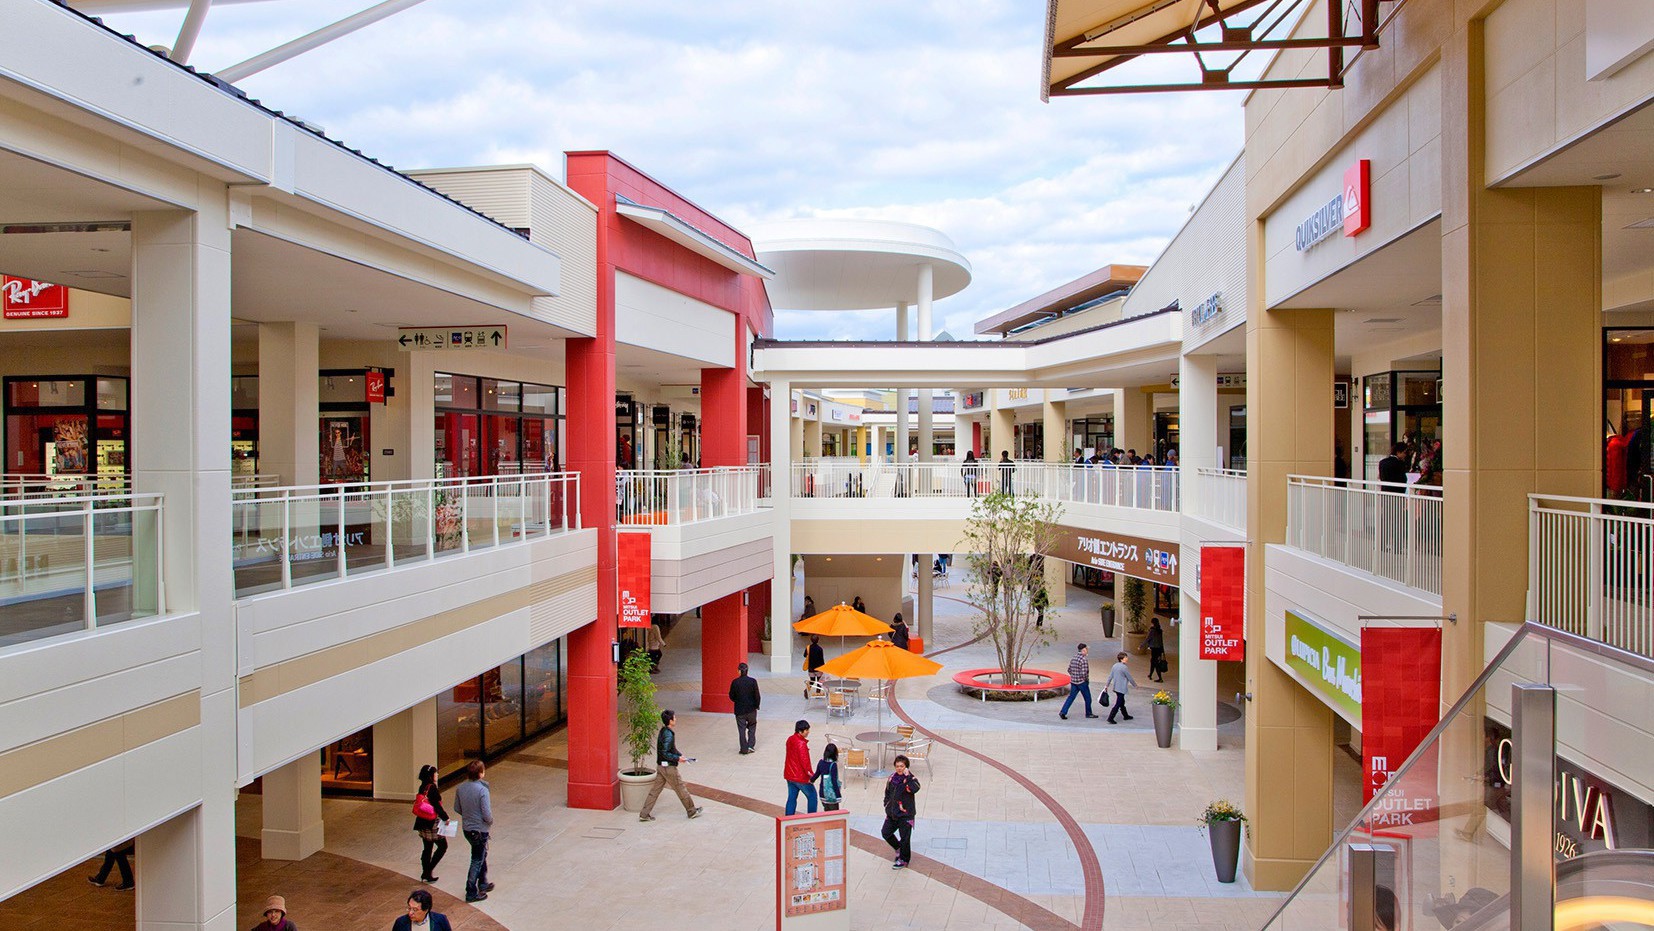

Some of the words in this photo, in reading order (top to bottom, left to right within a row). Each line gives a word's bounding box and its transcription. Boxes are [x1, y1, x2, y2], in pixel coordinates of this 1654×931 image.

[1295, 193, 1343, 252] QUIKSILVER
[1204, 639, 1238, 647] OUTLET
[1204, 647, 1228, 655] PARK
[1373, 788, 1404, 797] MSUI
[1372, 813, 1414, 825] PARK
[1555, 832, 1577, 858] 1926
